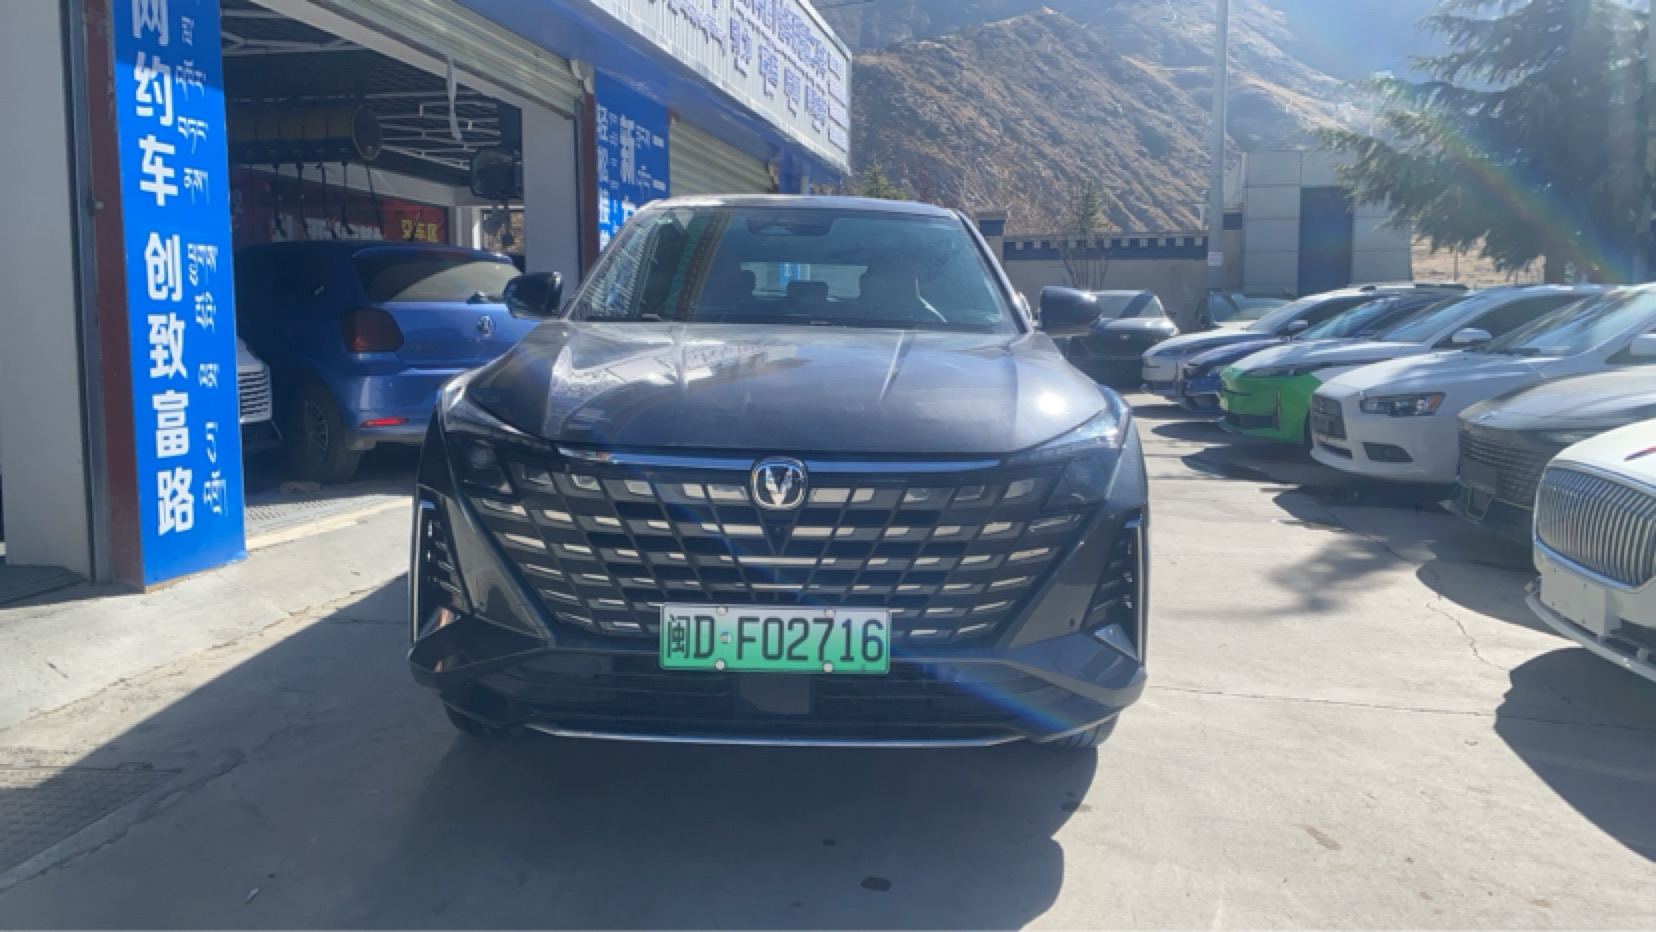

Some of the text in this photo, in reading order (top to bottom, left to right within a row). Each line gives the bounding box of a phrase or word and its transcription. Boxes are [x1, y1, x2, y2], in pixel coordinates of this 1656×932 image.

[131, 0, 178, 206] 网约车
[144, 231, 195, 536] 创致富路
[667, 613, 885, 663] 闽D F02716
